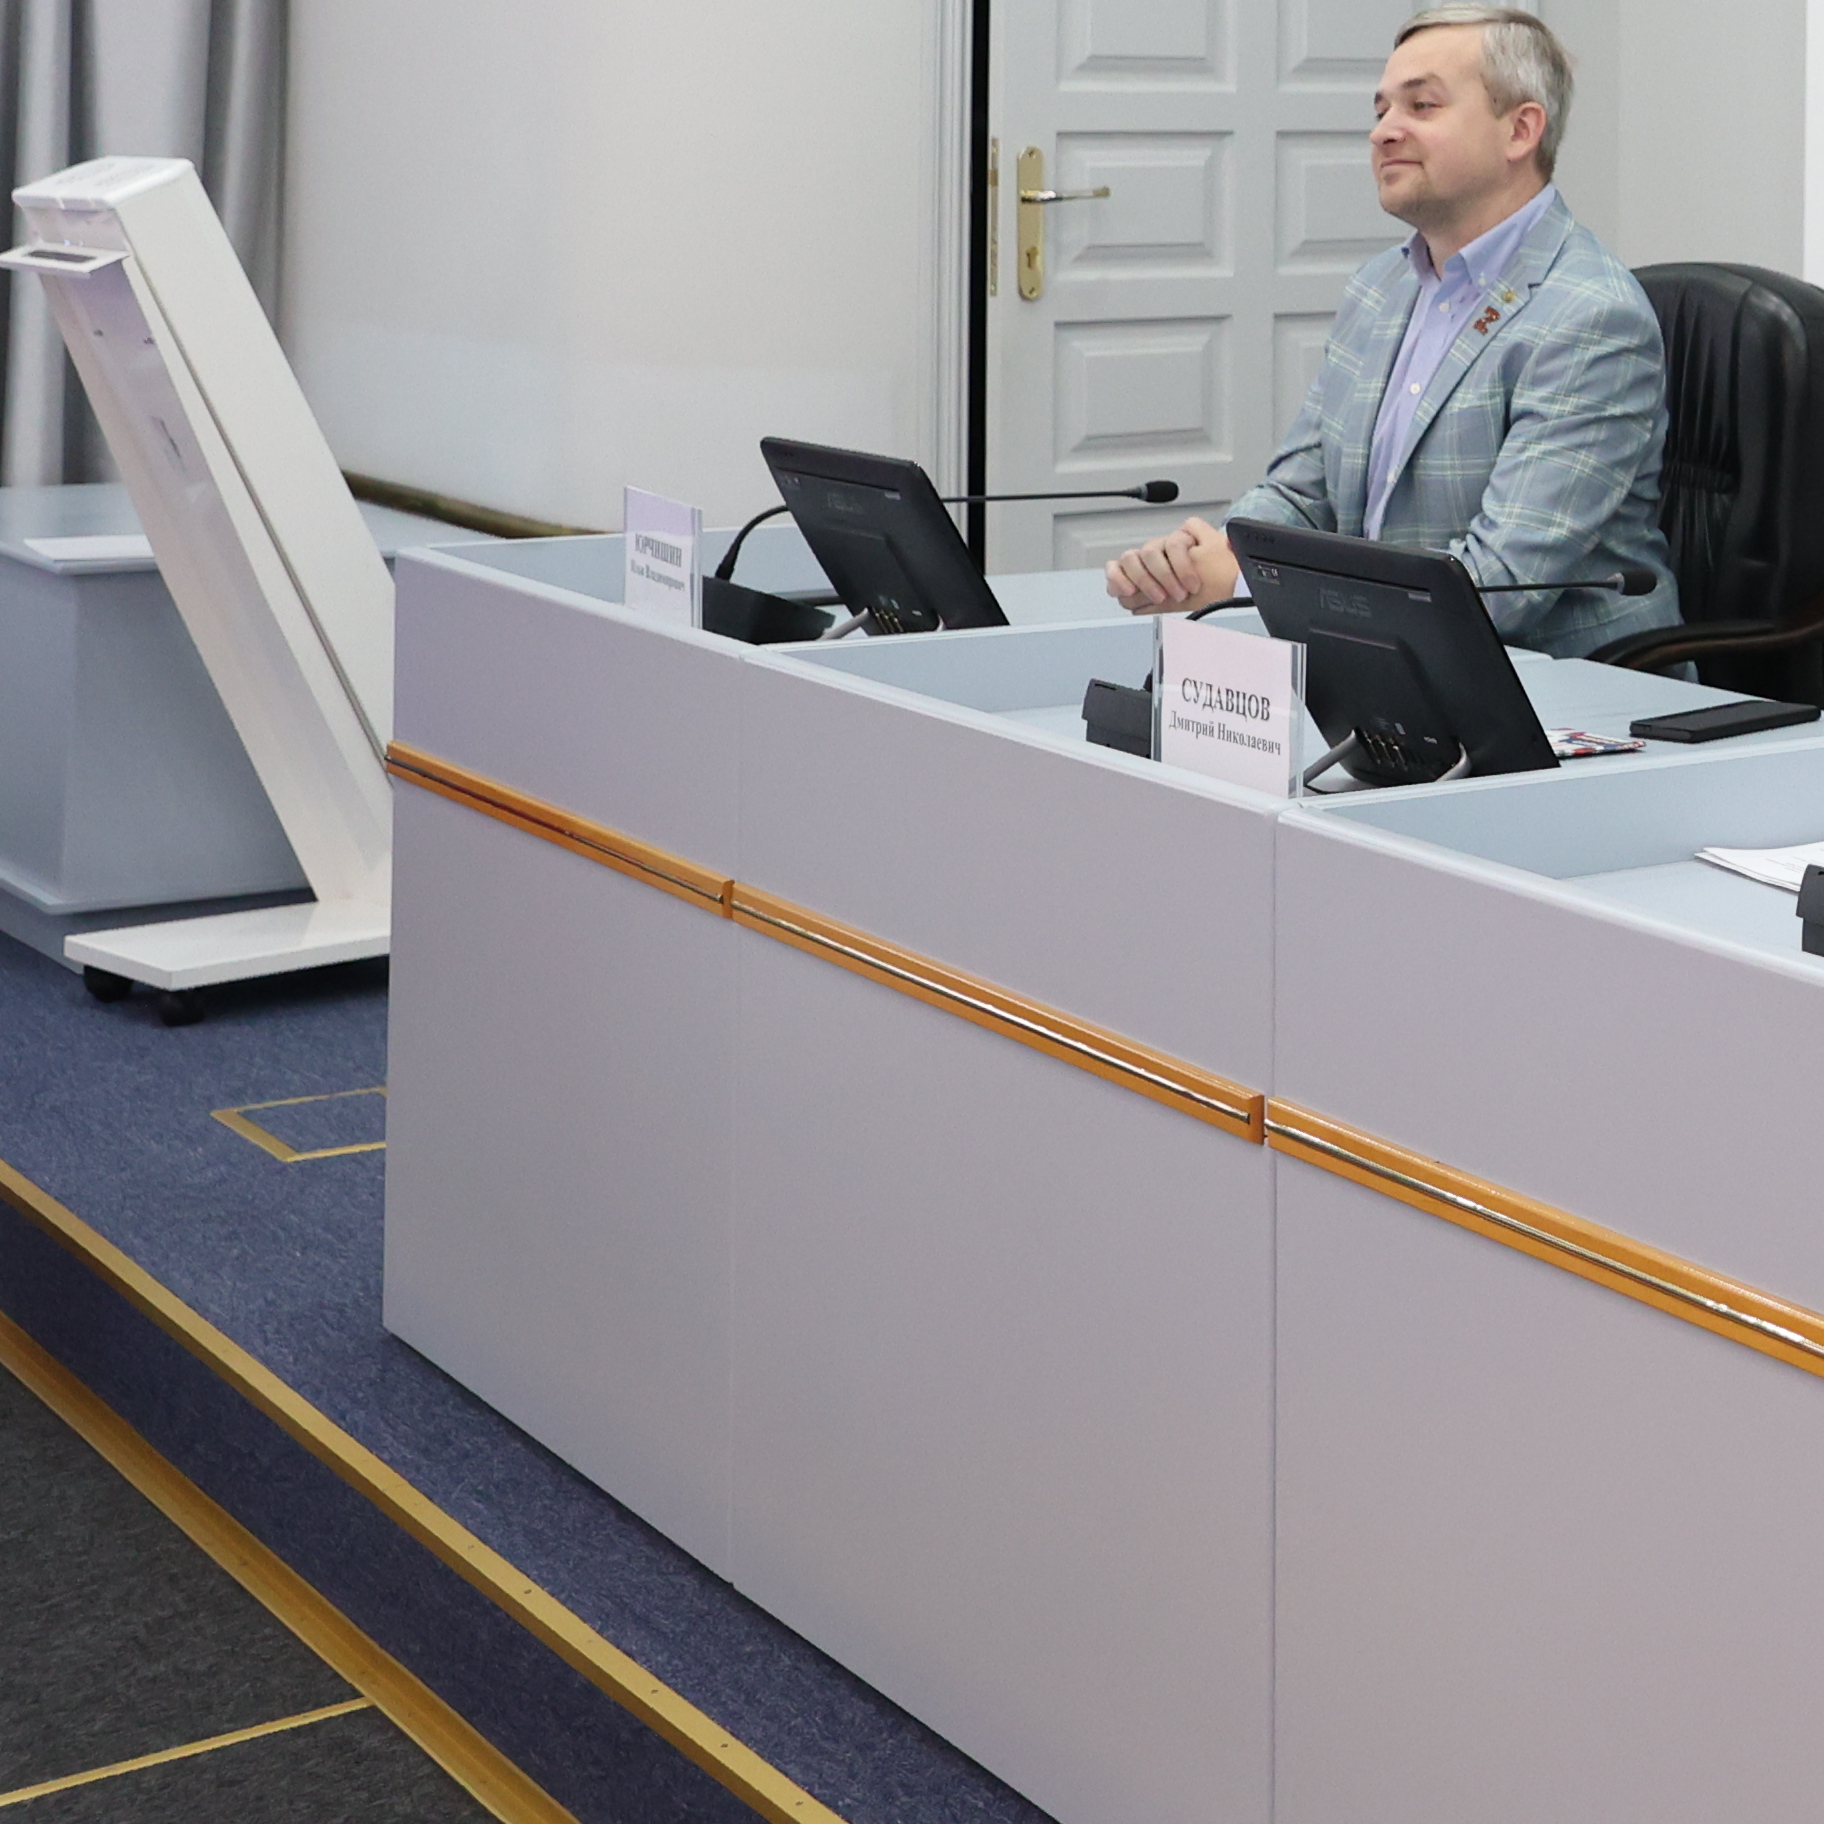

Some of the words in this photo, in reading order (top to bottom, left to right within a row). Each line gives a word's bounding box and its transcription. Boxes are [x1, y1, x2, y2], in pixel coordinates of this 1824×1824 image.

[1181, 677, 1271, 722] СУДАВЦОВ
[1168, 709, 1215, 739] Дмитрий
[1217, 722, 1281, 756] Николаевич
